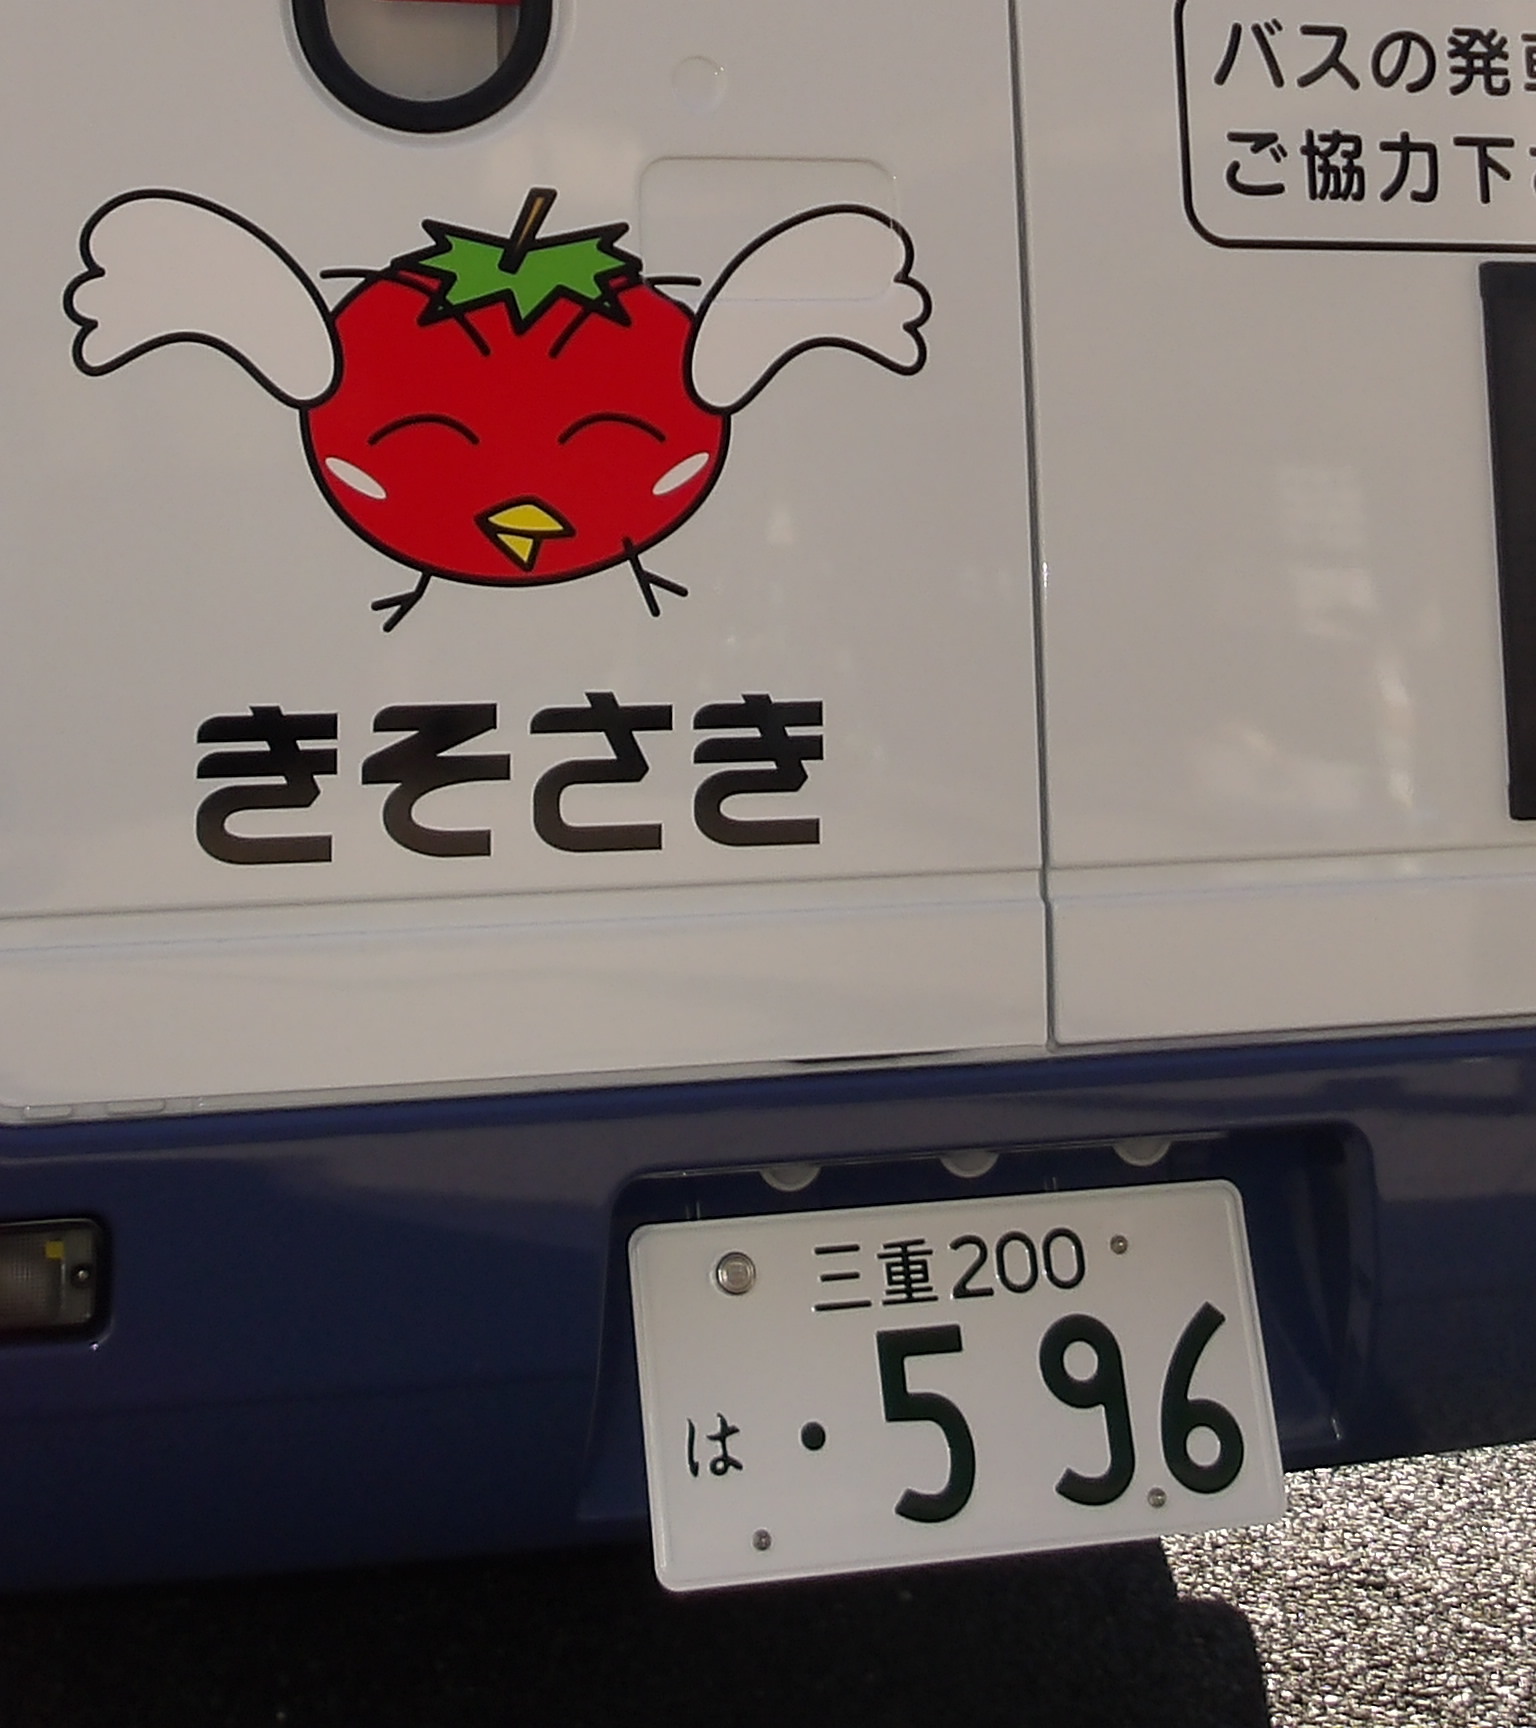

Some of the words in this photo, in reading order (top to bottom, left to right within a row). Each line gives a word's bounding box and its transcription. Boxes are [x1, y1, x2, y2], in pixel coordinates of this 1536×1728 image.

[196, 691, 824, 866] きそさき
[686, 1412, 743, 1478] は
